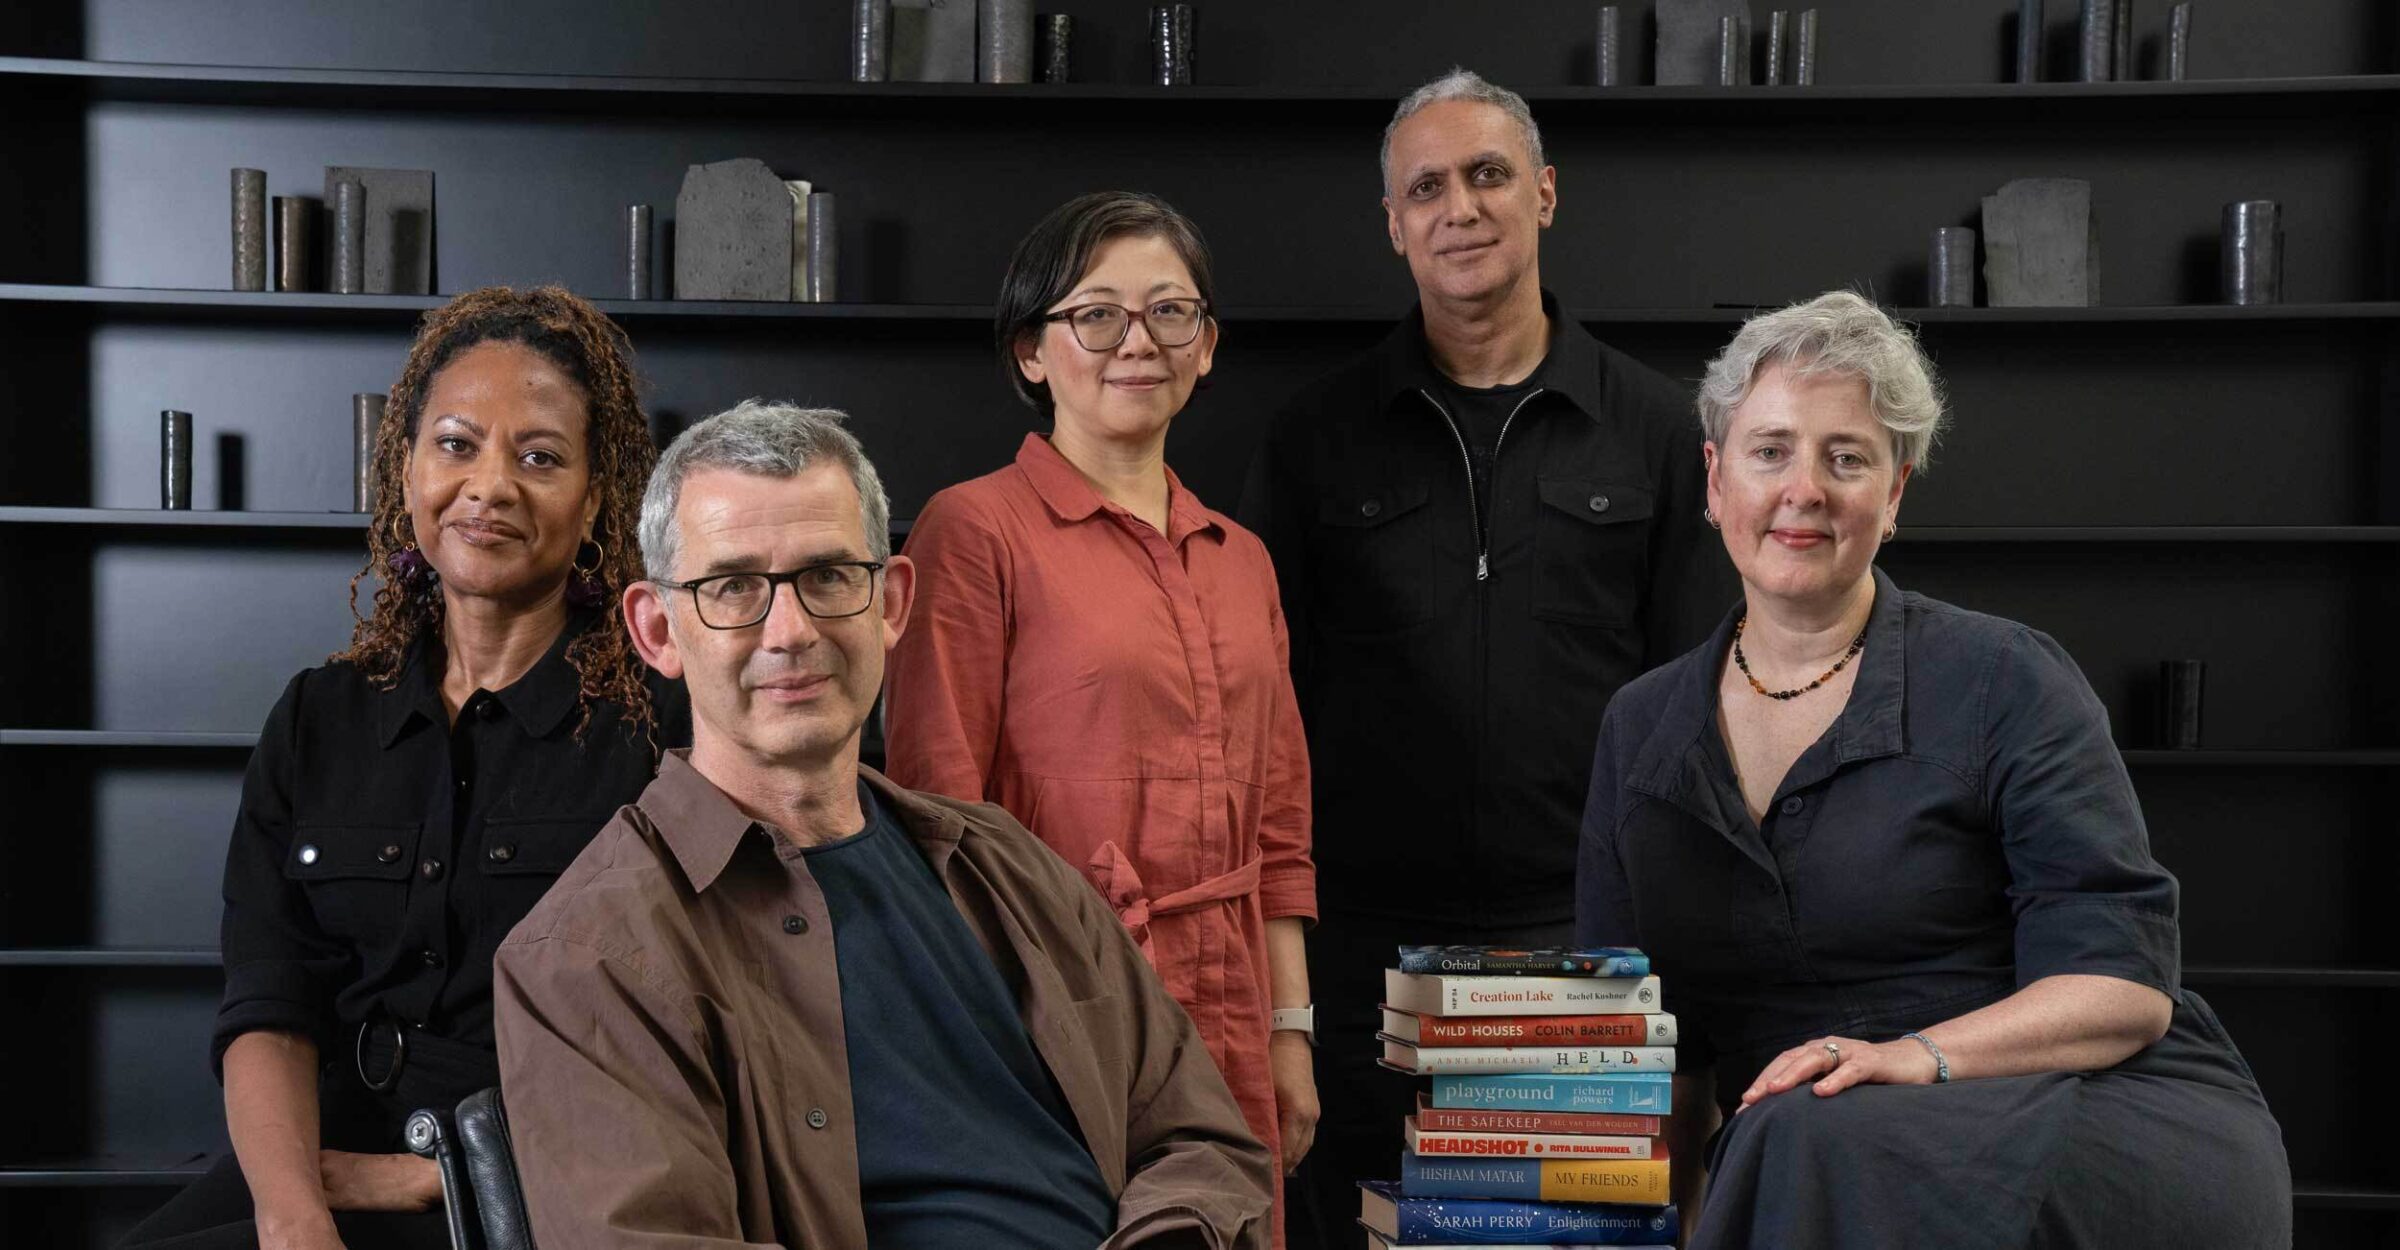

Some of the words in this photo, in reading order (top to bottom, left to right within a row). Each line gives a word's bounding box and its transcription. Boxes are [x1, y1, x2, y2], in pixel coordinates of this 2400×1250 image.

[1442, 960, 1480, 970] Orbital
[1486, 961, 1526, 969] SAMANTHA
[1470, 990, 1522, 1002] Creation
[1526, 990, 1554, 1002] Lake
[1566, 992, 1592, 1000] Rachel
[1594, 992, 1628, 1000] Kushner
[1434, 1026, 1466, 1036] WILD
[1472, 1026, 1523, 1036] HOUSES
[1536, 1025, 1574, 1036] COLIN
[1580, 1025, 1634, 1036] BARRETT
[1446, 1084, 1554, 1102] playground
[1573, 1086, 1614, 1096] richard
[1573, 1094, 1614, 1106] powers
[1438, 1116, 1464, 1126] THE
[1471, 1116, 1541, 1128] SAFEKEEP
[1420, 1138, 1528, 1155] HEADSHOT
[1550, 1144, 1572, 1152] RITA
[1573, 1144, 1631, 1154] BULLWINKEL
[1420, 1168, 1474, 1182] HISHAM
[1480, 1170, 1525, 1184] MATAR
[1555, 1172, 1578, 1185] MY
[1582, 1172, 1638, 1186] FRIENDS
[1434, 1216, 1482, 1228] SARAH
[1490, 1216, 1534, 1228] PERRY
[1548, 1216, 1641, 1230] Enlightenment
